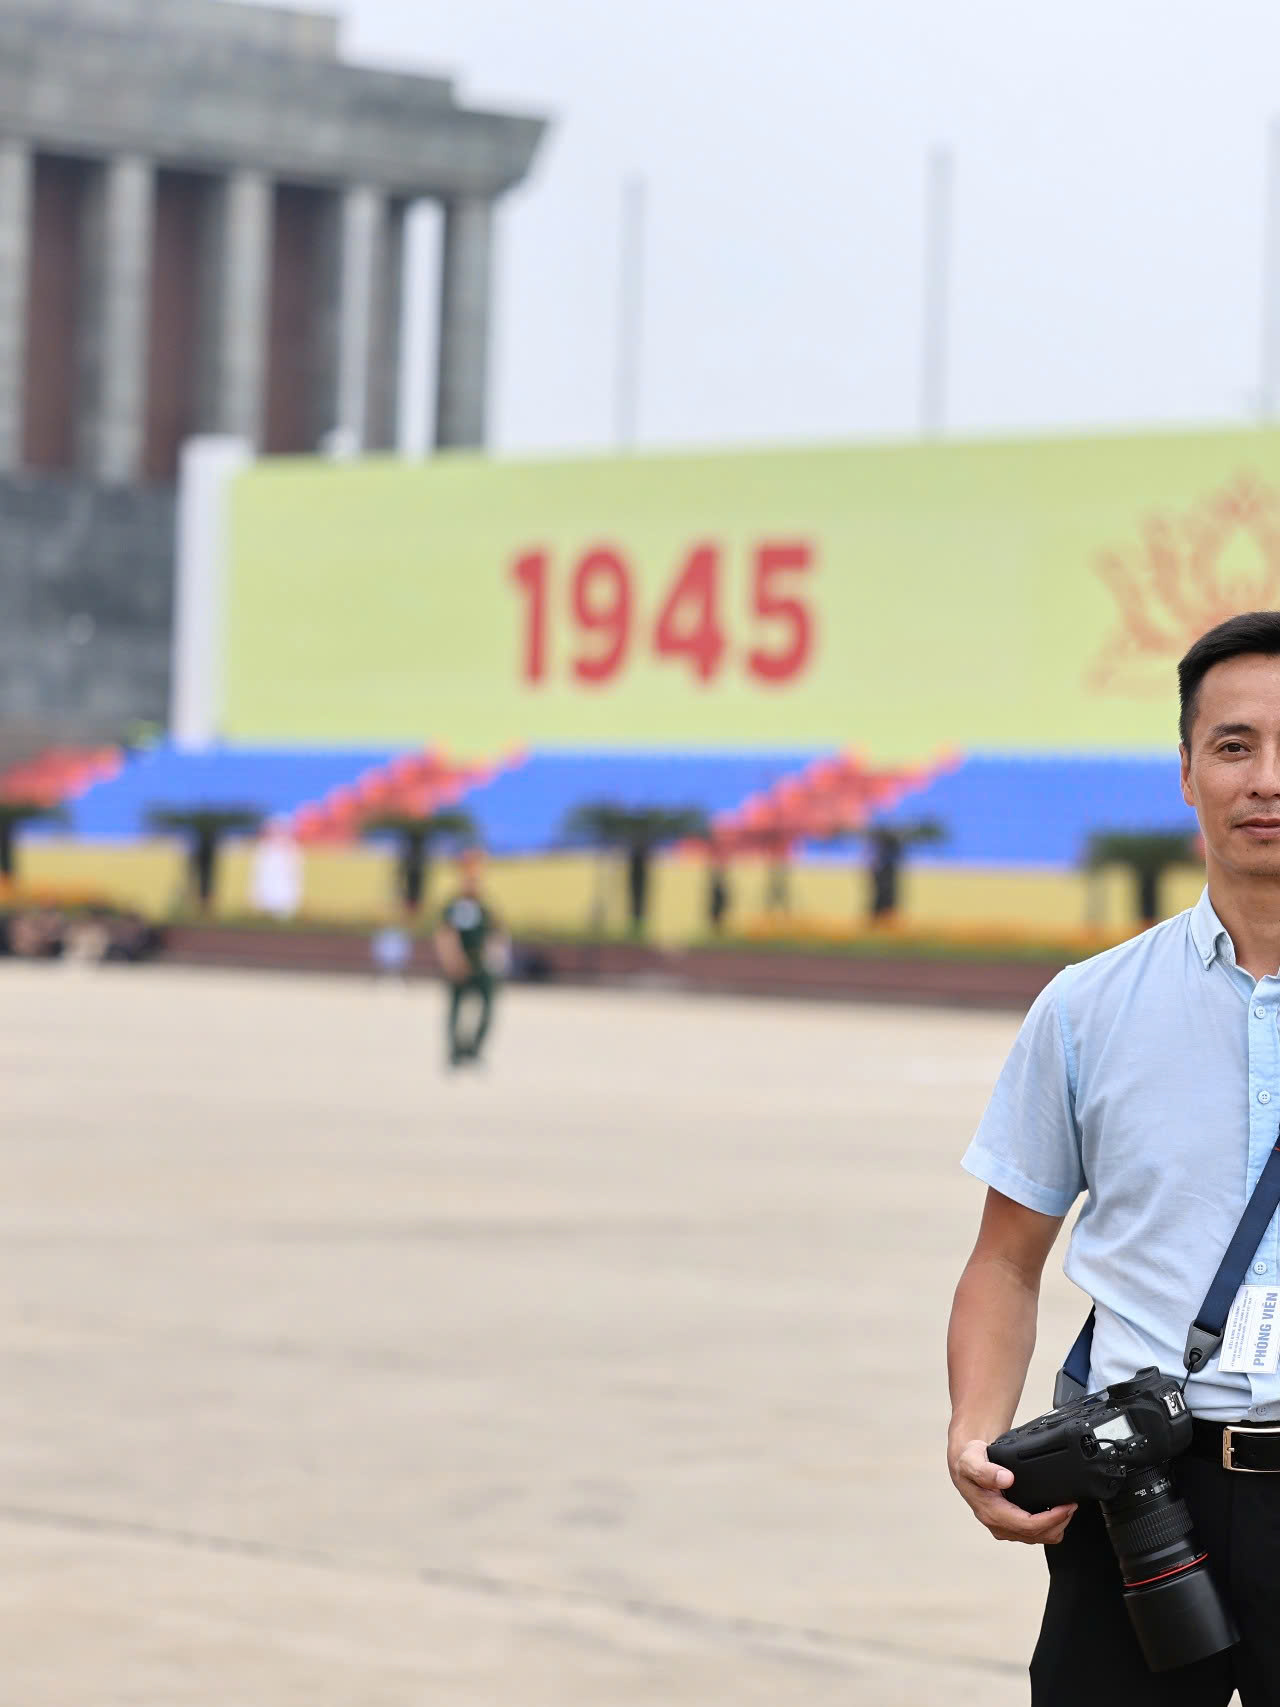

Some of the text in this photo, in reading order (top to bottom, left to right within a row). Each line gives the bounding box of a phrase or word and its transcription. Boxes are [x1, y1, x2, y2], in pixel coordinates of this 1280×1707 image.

[509, 541, 815, 687] 1945
[1253, 1292, 1279, 1367] PHÓNG VIÊN
